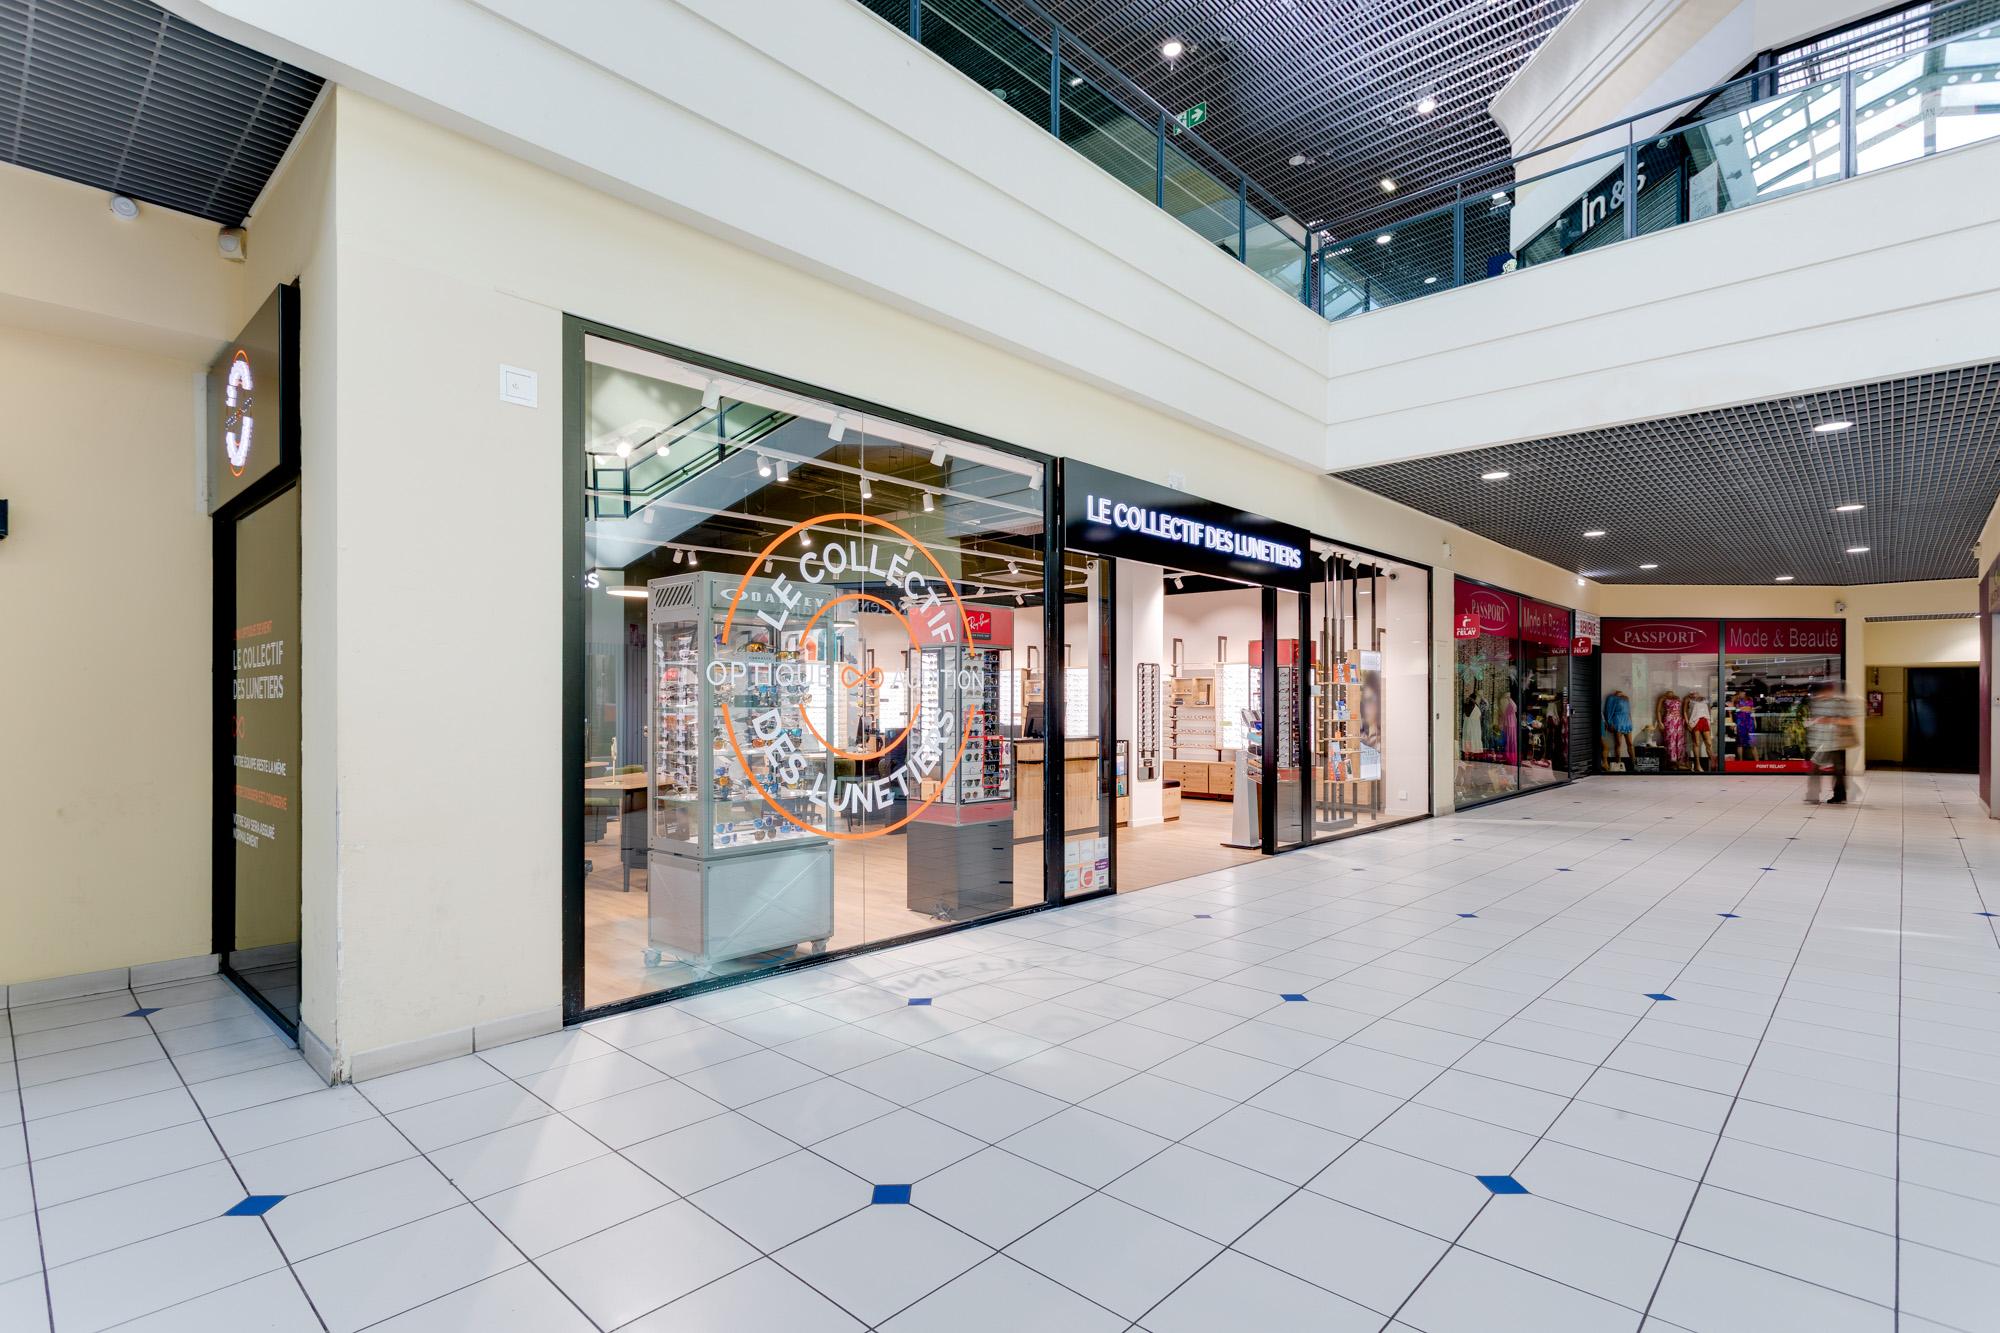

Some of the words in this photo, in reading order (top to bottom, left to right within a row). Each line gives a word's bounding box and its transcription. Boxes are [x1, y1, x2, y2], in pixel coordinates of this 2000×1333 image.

[1086, 494, 1113, 526] LE
[1112, 502, 1205, 546] COLLECTIF
[1204, 524, 1234, 553] DES
[1233, 532, 1302, 569] LUNETIERS
[757, 572, 803, 632] LE
[799, 541, 955, 643] COLLECTIF
[1471, 599, 1506, 623] PASSPORT
[1623, 631, 1697, 643] PASSPORT
[1729, 628, 1768, 648] Mode
[1773, 628, 1785, 648] &
[1789, 627, 1839, 648] Beauté
[232, 648, 242, 671] LE
[242, 640, 284, 669] COLLECTIF
[706, 660, 831, 687] OPTIQUE
[232, 677, 245, 700] DES
[245, 675, 284, 699] LUNETIERS
[751, 708, 808, 785] DES
[808, 708, 954, 814] LUNETIERS
